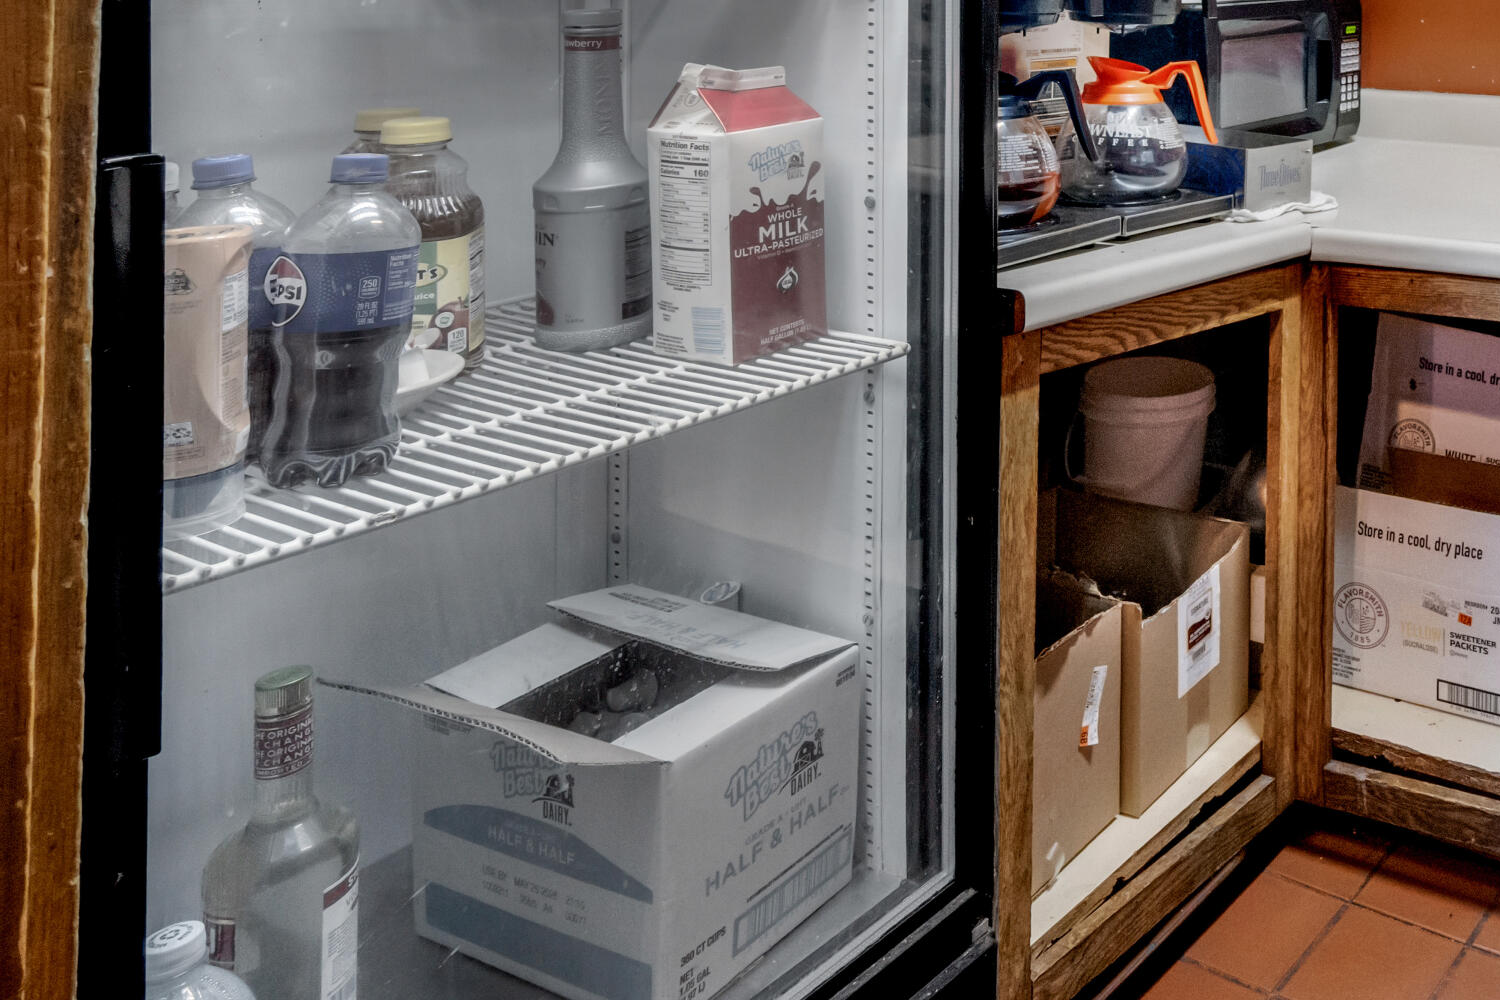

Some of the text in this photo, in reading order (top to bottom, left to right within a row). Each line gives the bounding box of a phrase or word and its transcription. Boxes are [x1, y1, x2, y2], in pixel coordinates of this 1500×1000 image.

[564, 38, 602, 48] awberry
[660, 140, 709, 151] Nutrition Facts
[1072, 136, 1148, 147] CFFEE
[693, 169, 708, 178] 160
[768, 207, 802, 223] WHOLE
[759, 216, 808, 243] MILK
[734, 228, 824, 259] ULTRA-PASTEURIZED
[362, 279, 378, 289] 250
[452, 330, 465, 339] 120
[1419, 356, 1443, 374] Store
[1445, 362, 1454, 376] in
[1456, 368, 1462, 378] a
[1393, 422, 1432, 447] FLAVORSMITH
[1357, 520, 1483, 560] Store in a cool, dry place
[1337, 587, 1385, 618] FLAVORSMITH
[1449, 631, 1497, 648] SWEETENER
[1449, 639, 1489, 655] PACKETS
[725, 711, 818, 807] Nature's
[504, 769, 544, 799] Best
[744, 753, 792, 822] Best
[790, 762, 819, 796] DAIRY
[542, 800, 570, 825] DAIRY
[488, 826, 522, 847] HALF
[539, 843, 575, 865] HALF
[705, 783, 840, 897] HALF & HALF
[696, 941, 706, 956] CT
[707, 926, 727, 947] CUPS
[680, 968, 694, 985] NET
